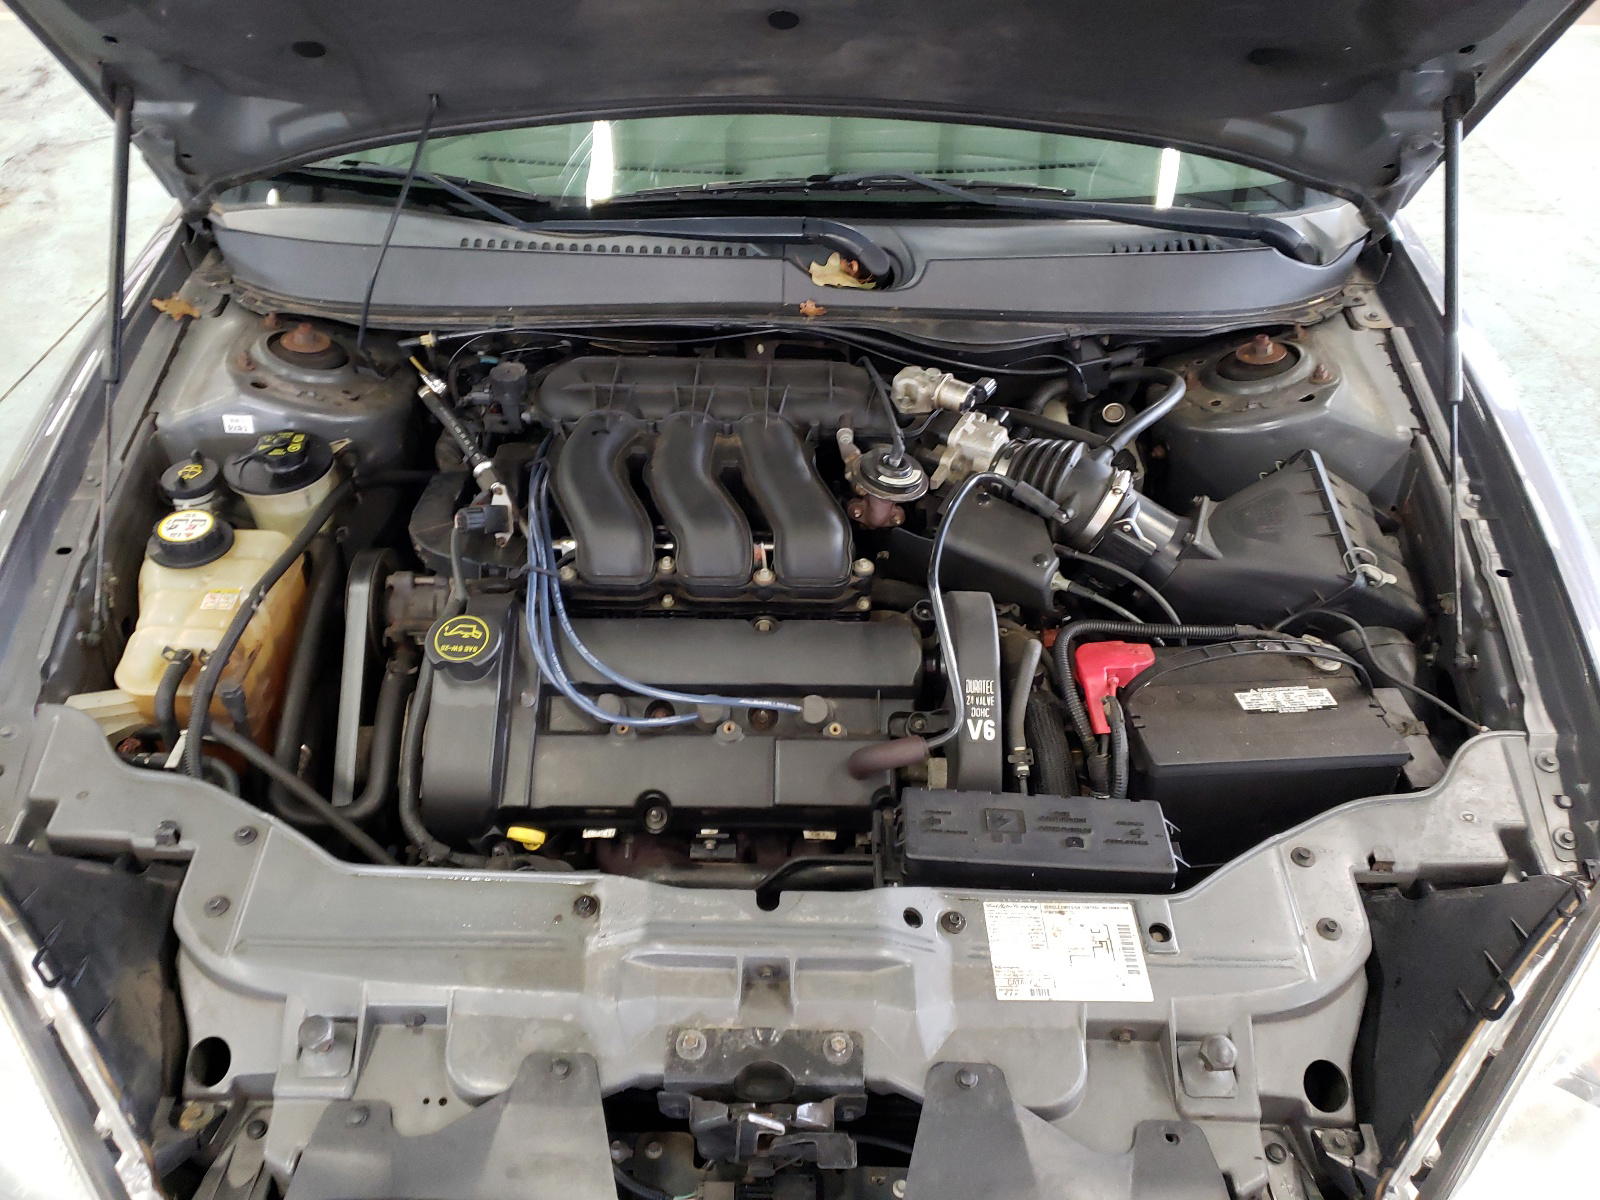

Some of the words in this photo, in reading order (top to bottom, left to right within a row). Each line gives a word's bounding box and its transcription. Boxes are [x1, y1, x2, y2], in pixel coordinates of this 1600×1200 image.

[966, 680, 994, 694] DURATEC
[975, 695, 995, 706] VALVE
[971, 707, 990, 718] DOHC
[966, 718, 995, 741] V6
